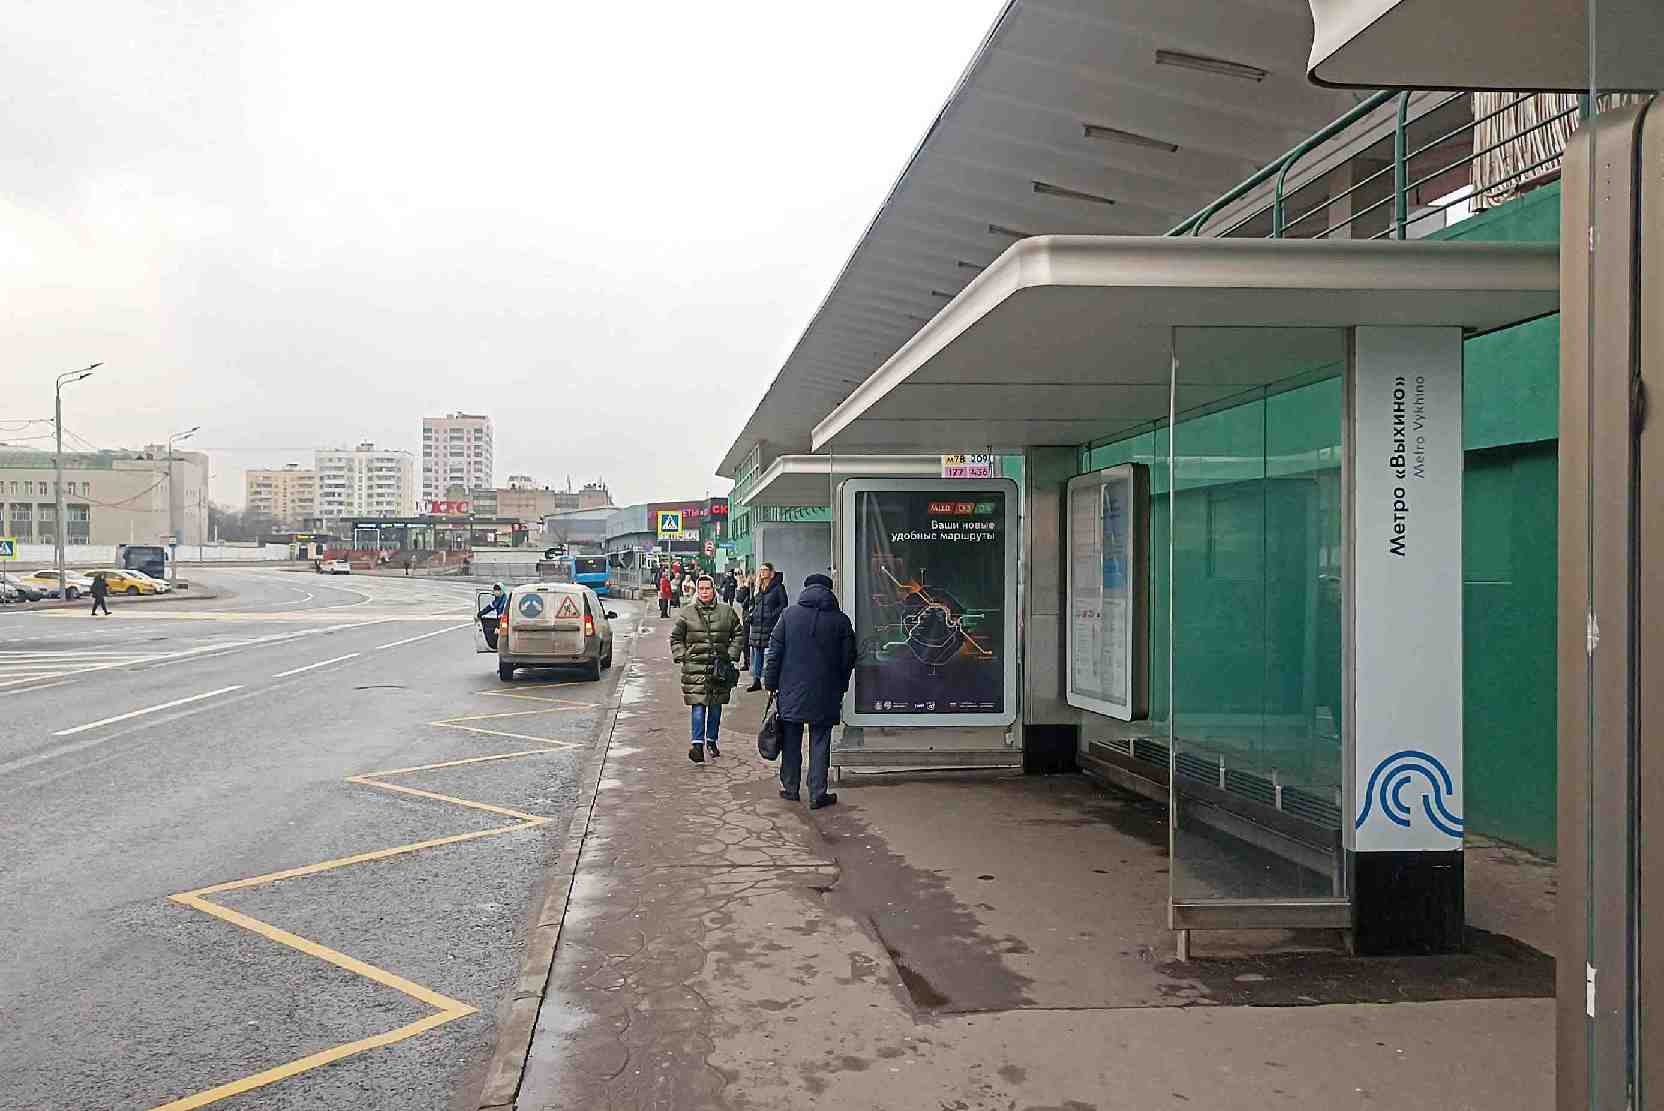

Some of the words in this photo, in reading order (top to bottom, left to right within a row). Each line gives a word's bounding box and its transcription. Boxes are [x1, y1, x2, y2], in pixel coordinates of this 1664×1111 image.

[1389, 376, 1406, 480] «Выхино»
[1413, 376, 1426, 431] Vykhino
[1413, 436, 1425, 479] Metro
[891, 531, 937, 542] удобные
[940, 532, 995, 542] маршруты
[931, 520, 959, 530] Ваши
[962, 522, 996, 530] новые
[1389, 487, 1408, 556] Метро
